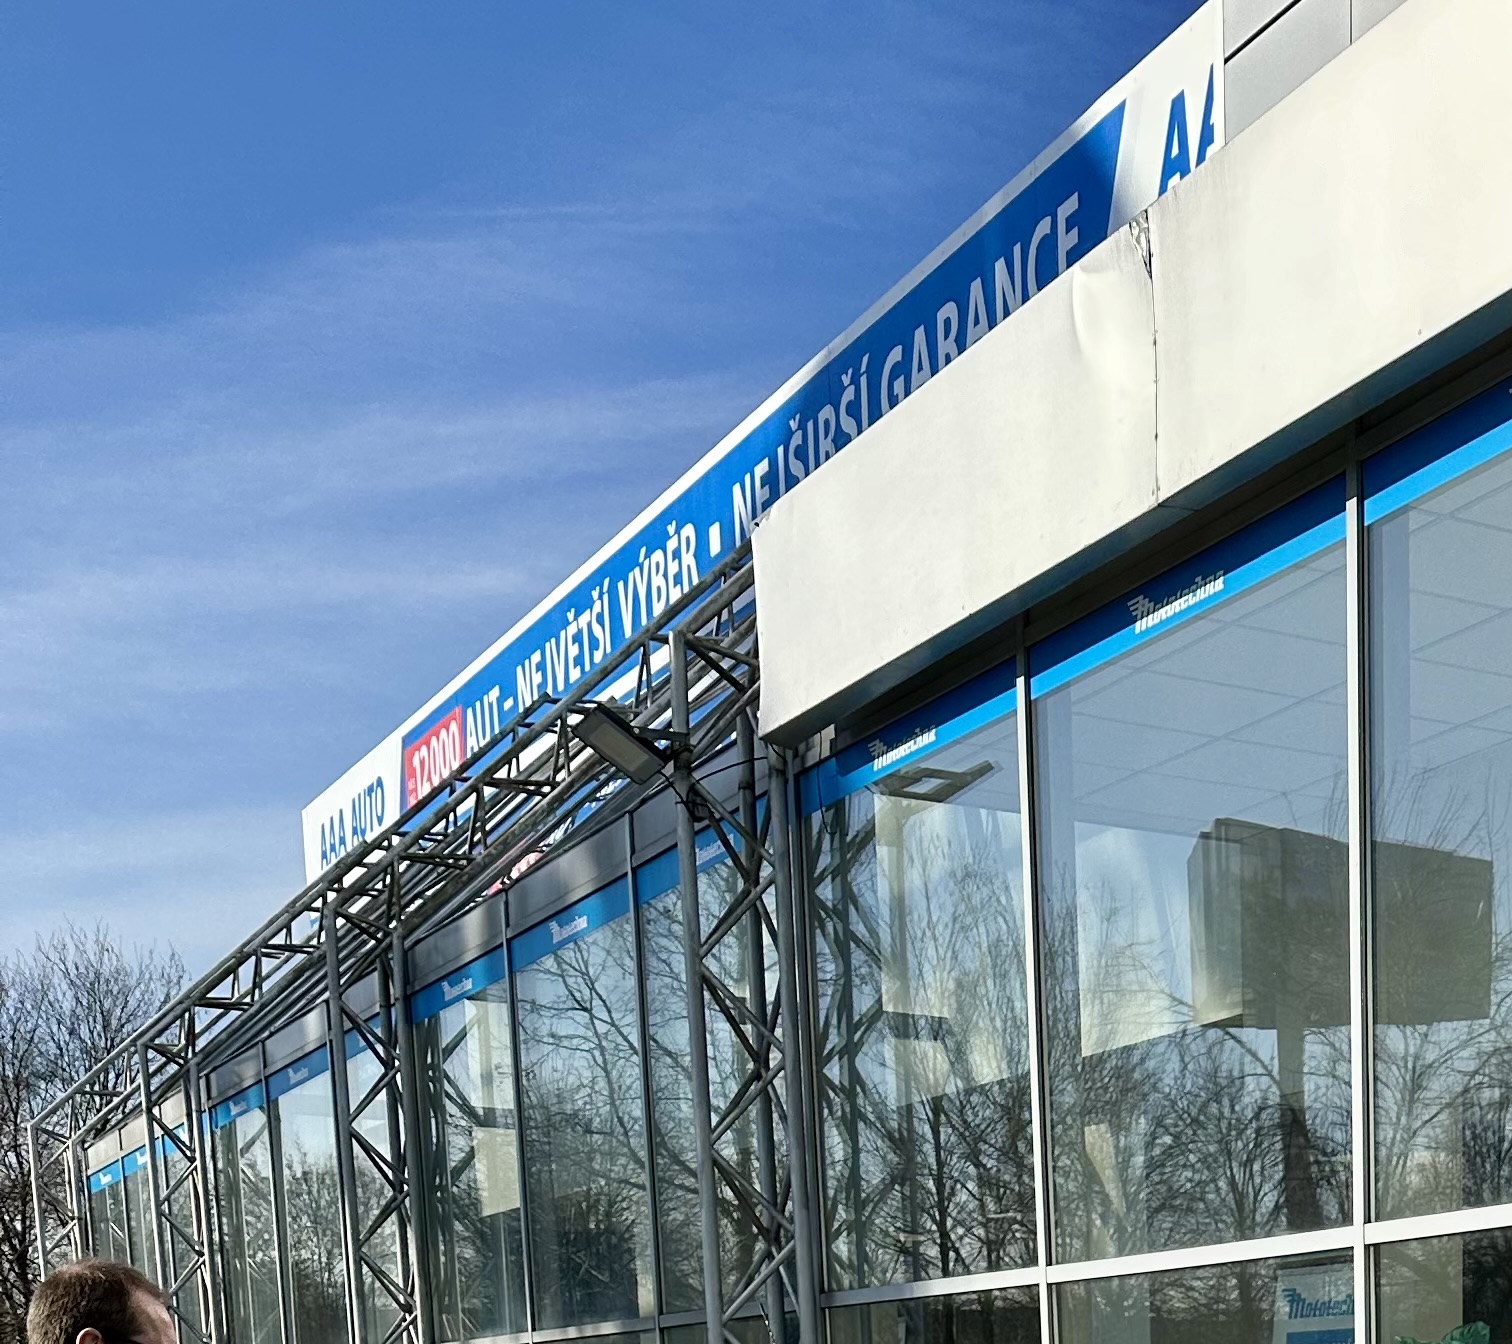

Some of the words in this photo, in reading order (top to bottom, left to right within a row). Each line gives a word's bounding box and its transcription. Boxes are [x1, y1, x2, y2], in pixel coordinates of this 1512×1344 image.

[412, 719, 462, 802] 12000
[466, 685, 500, 757] AUT
[516, 576, 611, 712] NEJVĚTŠÍ
[617, 519, 699, 639] VÝBĚR
[732, 352, 870, 547] NEJŠIRŠÍ
[880, 191, 1080, 415] GARANCE
[1127, 569, 1225, 635] Mototechna
[320, 807, 348, 871] AAA
[351, 775, 386, 846] AUTO
